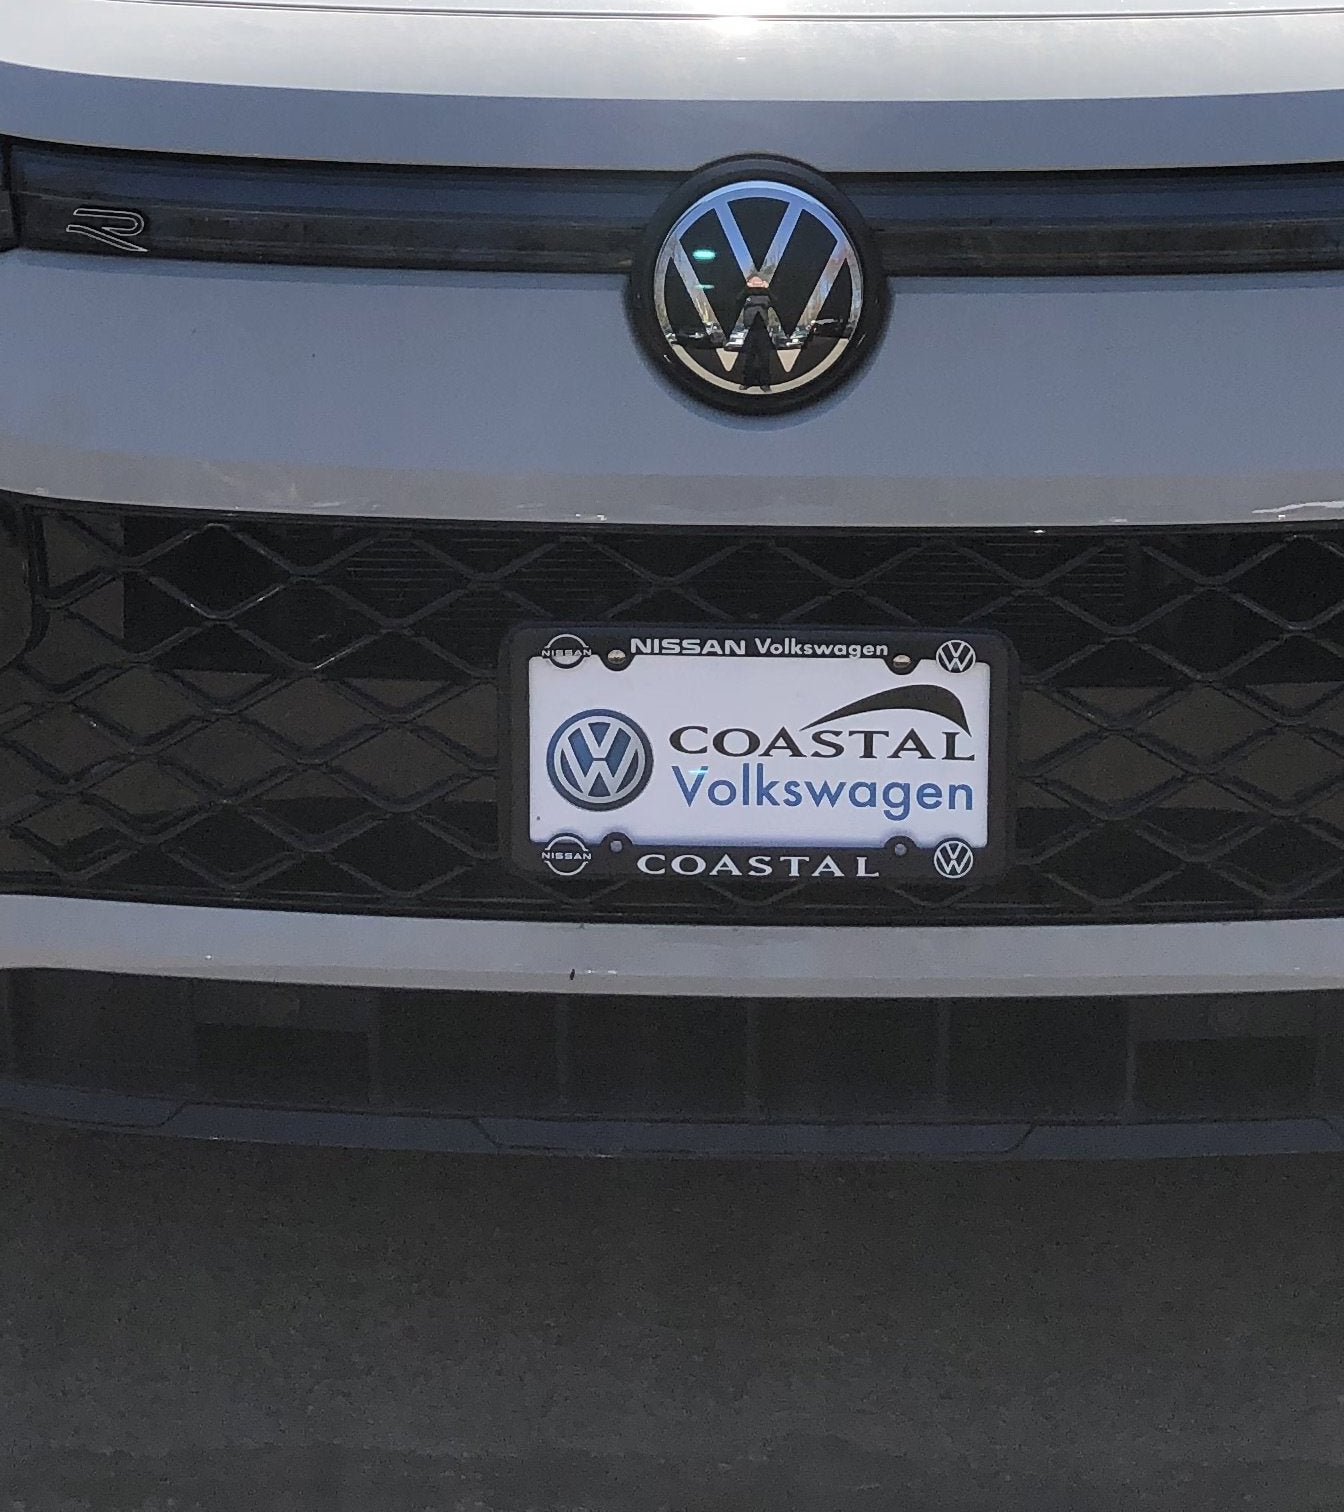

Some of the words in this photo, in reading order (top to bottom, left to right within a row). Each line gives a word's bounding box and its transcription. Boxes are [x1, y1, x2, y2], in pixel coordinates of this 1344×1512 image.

[541, 648, 592, 657] NISSAN
[630, 637, 746, 656] NISSAN
[754, 637, 889, 659] Volkswagen
[668, 724, 976, 762] COASTAL
[555, 715, 645, 804] VW
[670, 762, 974, 822] Volkswagen
[541, 850, 592, 861] NISSAN
[636, 853, 880, 878] COASTAL
